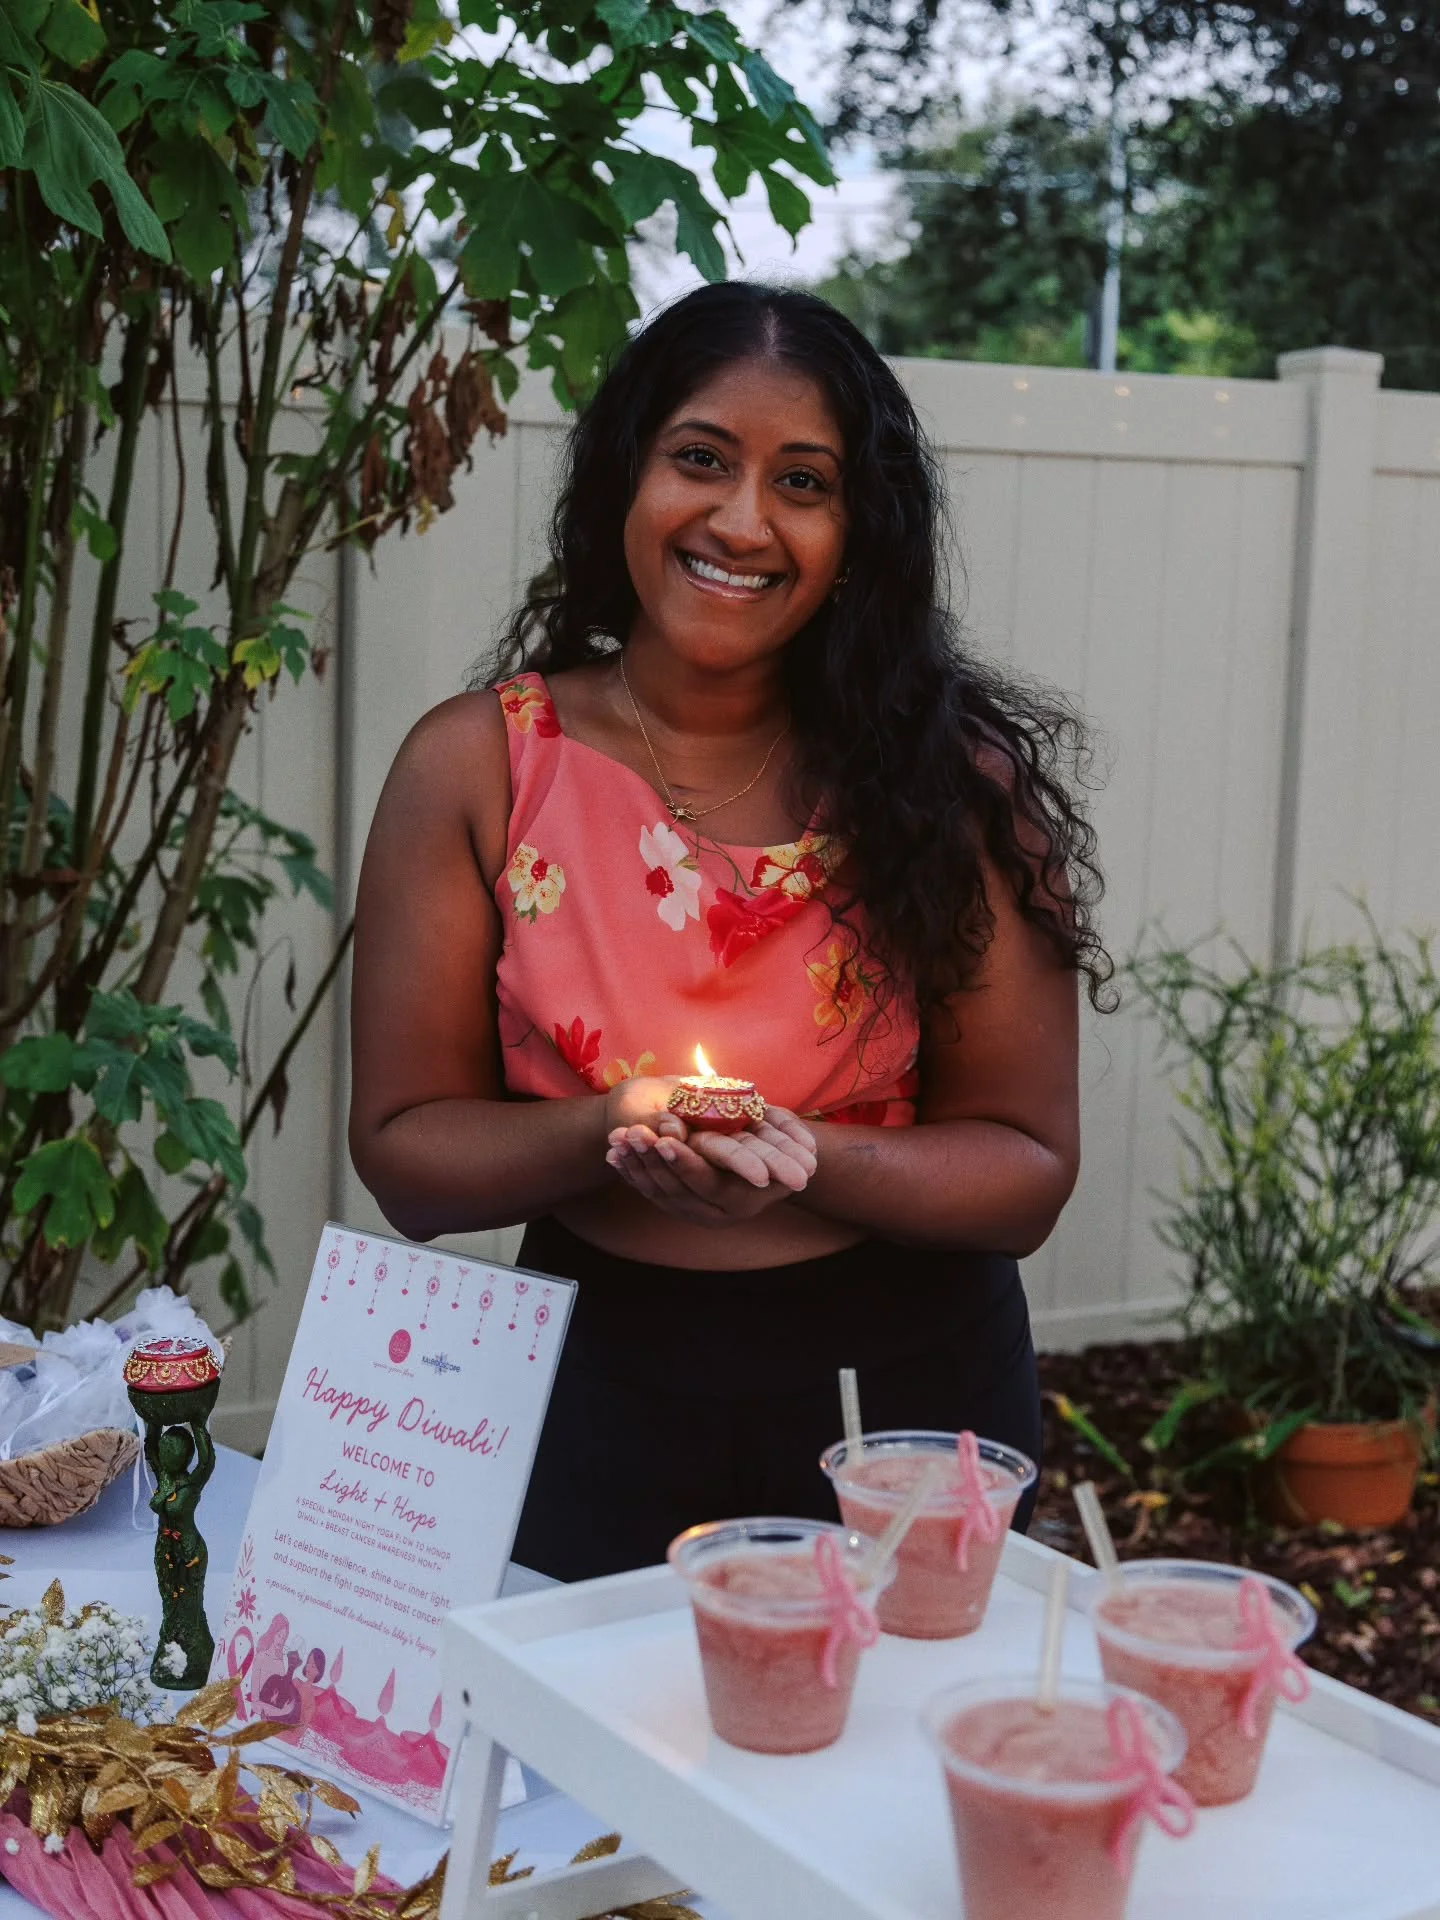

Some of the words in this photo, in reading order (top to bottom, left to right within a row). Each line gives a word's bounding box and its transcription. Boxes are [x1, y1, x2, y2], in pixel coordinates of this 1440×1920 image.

[303, 1366, 389, 1432] Happy
[398, 1397, 509, 1458] Diwali!
[343, 1441, 411, 1480] WELCOME
[417, 1466, 435, 1487] TO
[302, 1498, 325, 1514] SPECIAL
[328, 1508, 353, 1523] MONDAY
[356, 1518, 375, 1531] NIGHT
[377, 1527, 393, 1539] YOGA
[395, 1532, 413, 1547] FLOW
[416, 1541, 425, 1551] TO
[426, 1546, 451, 1560] HONOR
[320, 1469, 367, 1504] Light
[374, 1491, 387, 1512] +
[392, 1496, 437, 1532] Hope
[274, 1528, 292, 1545] Let's
[293, 1538, 329, 1560] celebrate
[331, 1553, 368, 1577] resilience,
[371, 1568, 392, 1585] shine
[393, 1579, 407, 1592] our
[408, 1584, 429, 1600] inner
[297, 1510, 318, 1525] DIWALI
[325, 1521, 350, 1536] BREAST
[351, 1531, 376, 1546] CANCER
[377, 1542, 416, 1562] AWARENESS
[418, 1556, 441, 1571] MONTH
[273, 1551, 288, 1564] and
[289, 1558, 318, 1577] support
[319, 1568, 332, 1582] the
[334, 1572, 352, 1590] fight
[353, 1584, 383, 1604] against
[384, 1593, 410, 1614] breast
[333, 1605, 349, 1618] will
